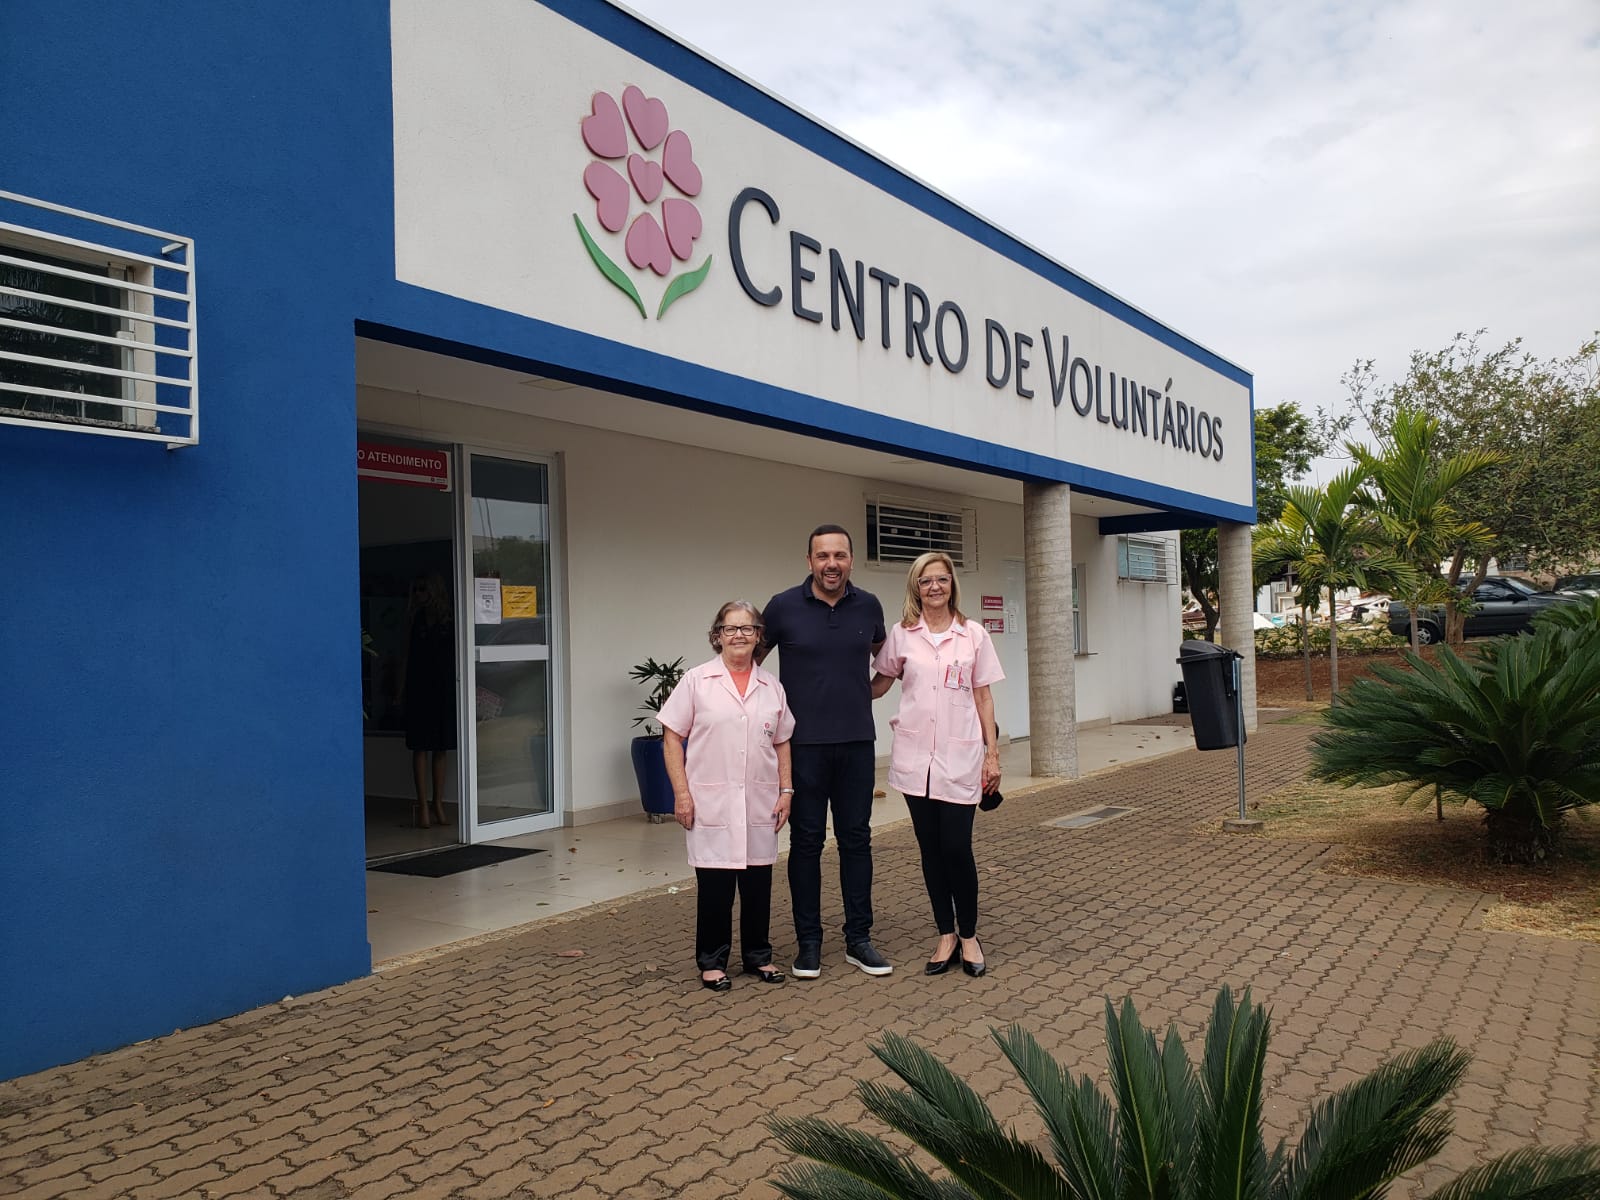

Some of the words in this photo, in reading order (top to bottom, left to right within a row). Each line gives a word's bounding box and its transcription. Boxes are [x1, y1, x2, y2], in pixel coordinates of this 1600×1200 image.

[728, 186, 969, 374] CENTRO
[985, 318, 1034, 399] DE
[1041, 326, 1224, 462] VOLUNTÁRIOS
[367, 451, 442, 470] ATENDIMENTO
